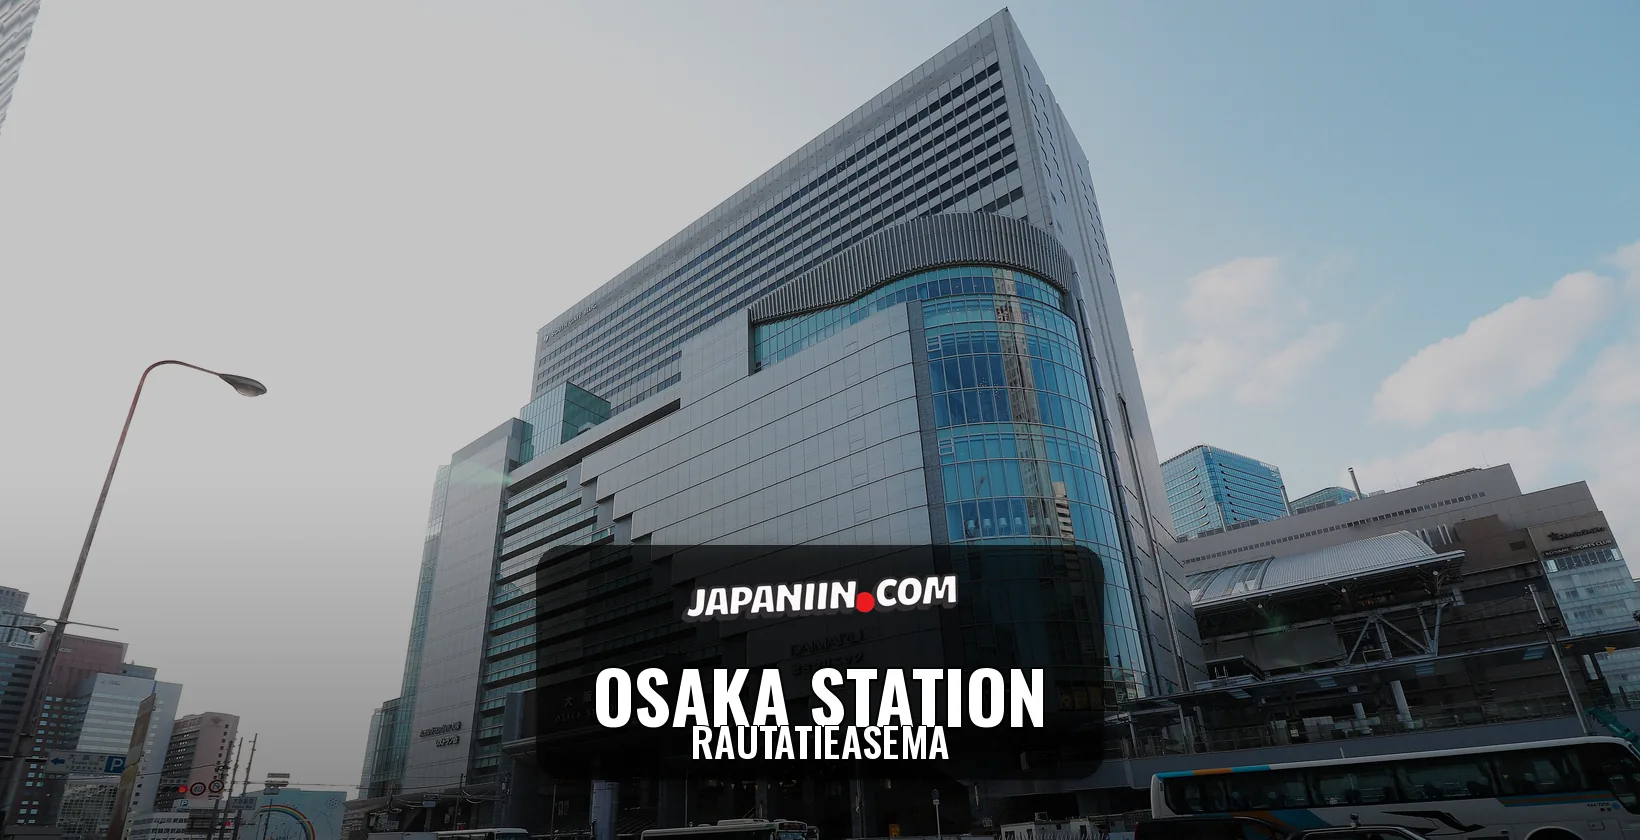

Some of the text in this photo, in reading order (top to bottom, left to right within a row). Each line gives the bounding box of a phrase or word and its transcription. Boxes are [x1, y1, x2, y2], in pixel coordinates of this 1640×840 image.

[1546, 538, 1612, 556] KONAMI SPORTS CLUB
[193, 785, 203, 793] 40
